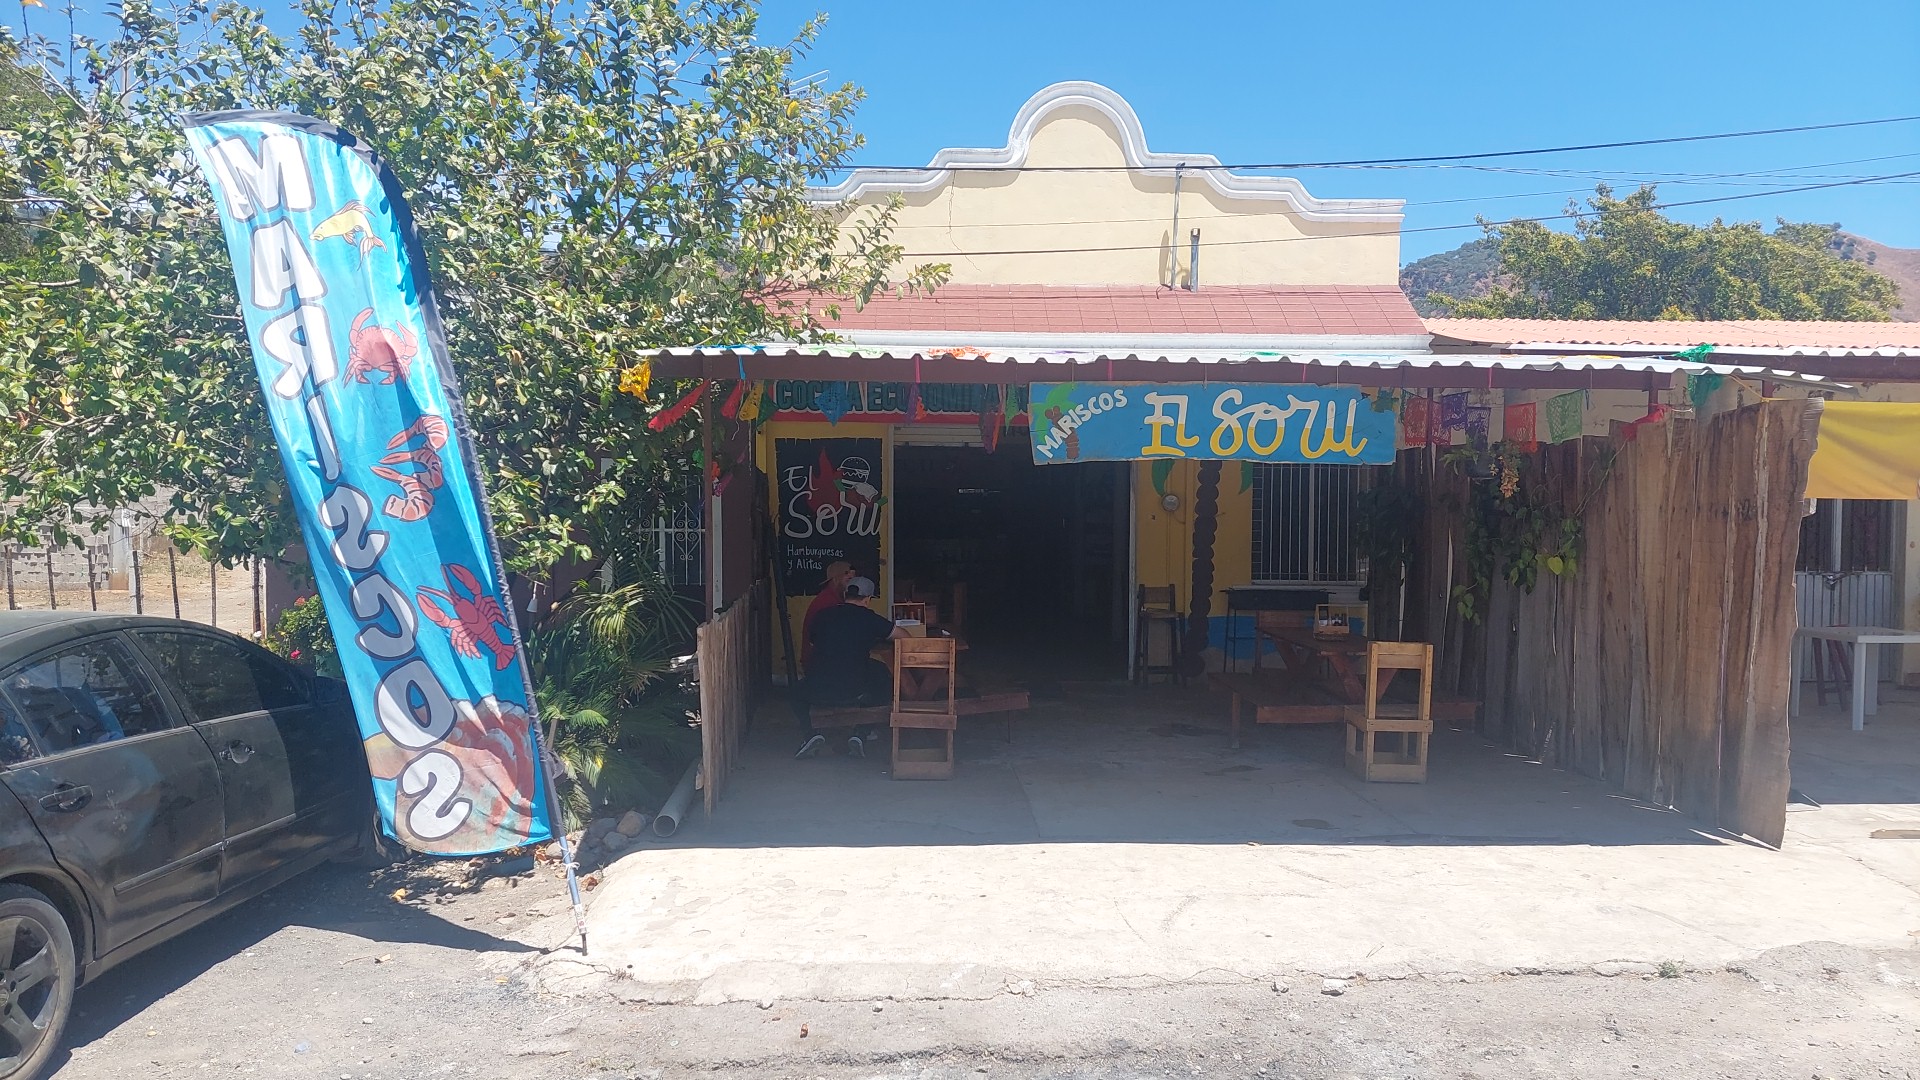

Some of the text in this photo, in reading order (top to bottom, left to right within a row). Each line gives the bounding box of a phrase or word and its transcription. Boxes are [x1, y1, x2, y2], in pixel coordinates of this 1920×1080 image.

[1036, 389, 1128, 458] MARISCOS
[782, 465, 819, 492] El
[784, 490, 881, 539] Soru
[787, 544, 844, 559] Hamburguesas
[787, 558, 822, 571] y Alitas
